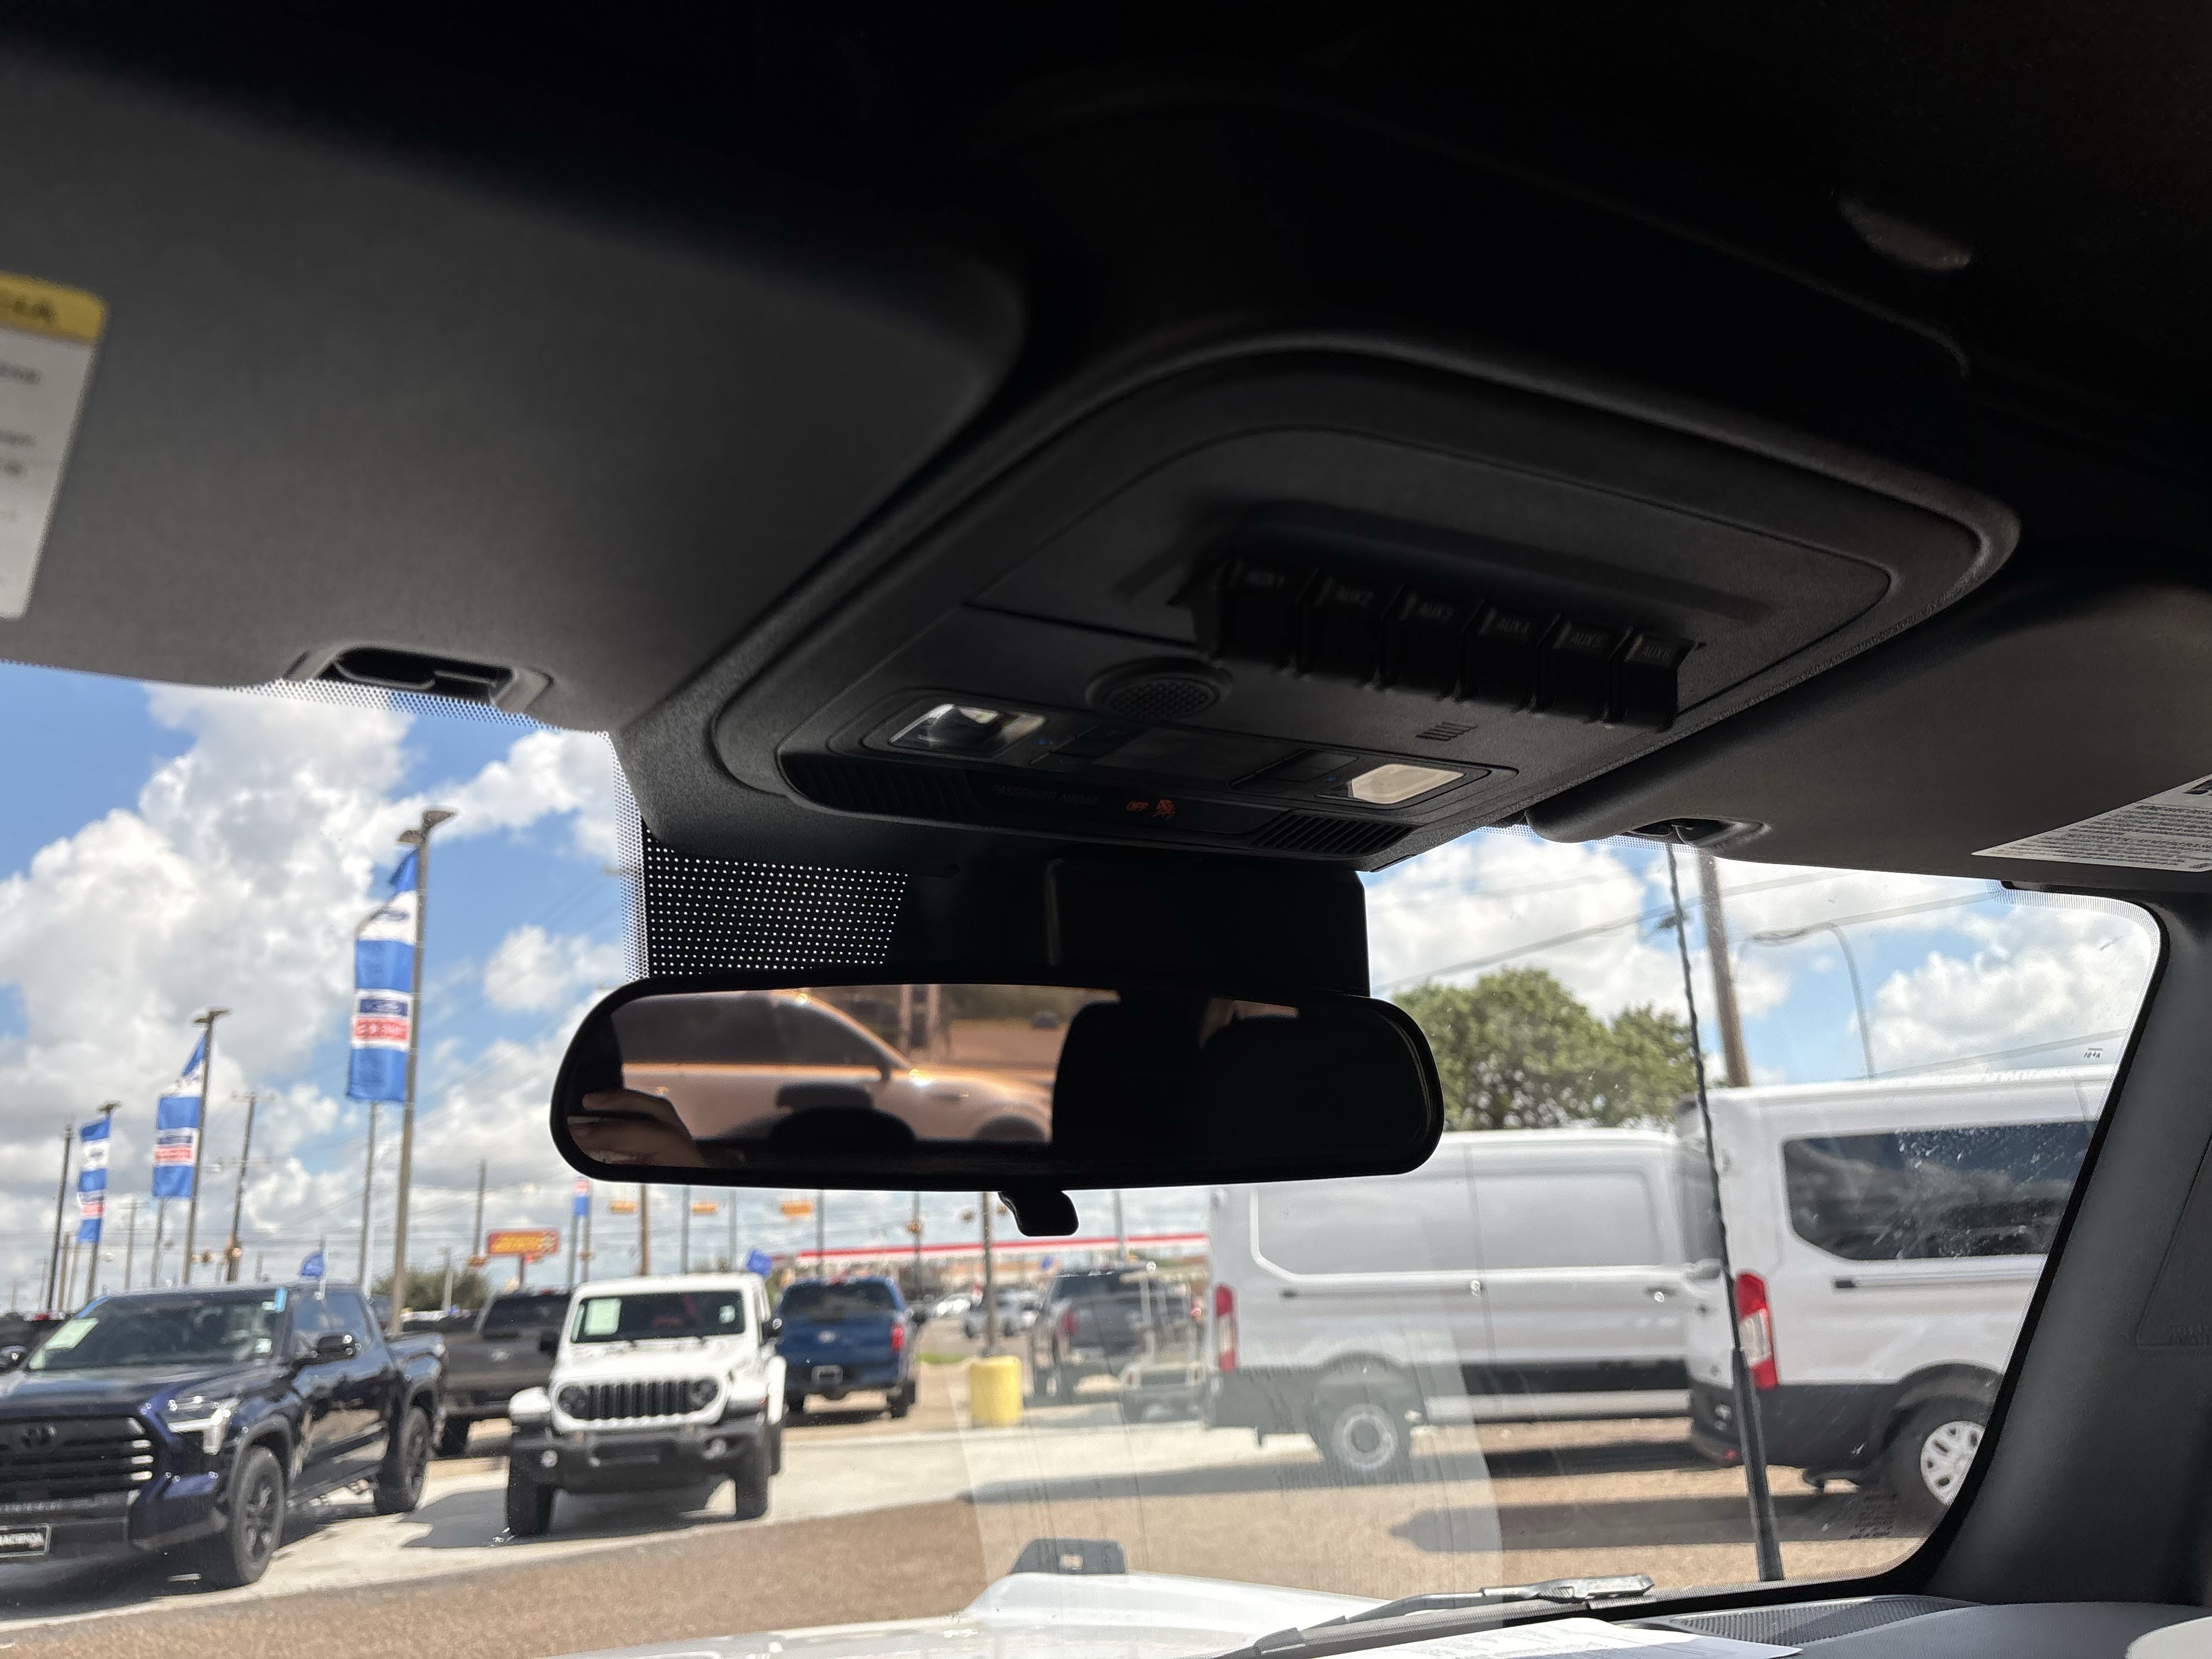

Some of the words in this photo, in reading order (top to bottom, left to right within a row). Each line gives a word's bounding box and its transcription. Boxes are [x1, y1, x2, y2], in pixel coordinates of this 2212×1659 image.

[991, 785, 1057, 801] PASSENGER
[1058, 792, 1099, 806] AIRBAG
[1126, 800, 1149, 812] OFF
